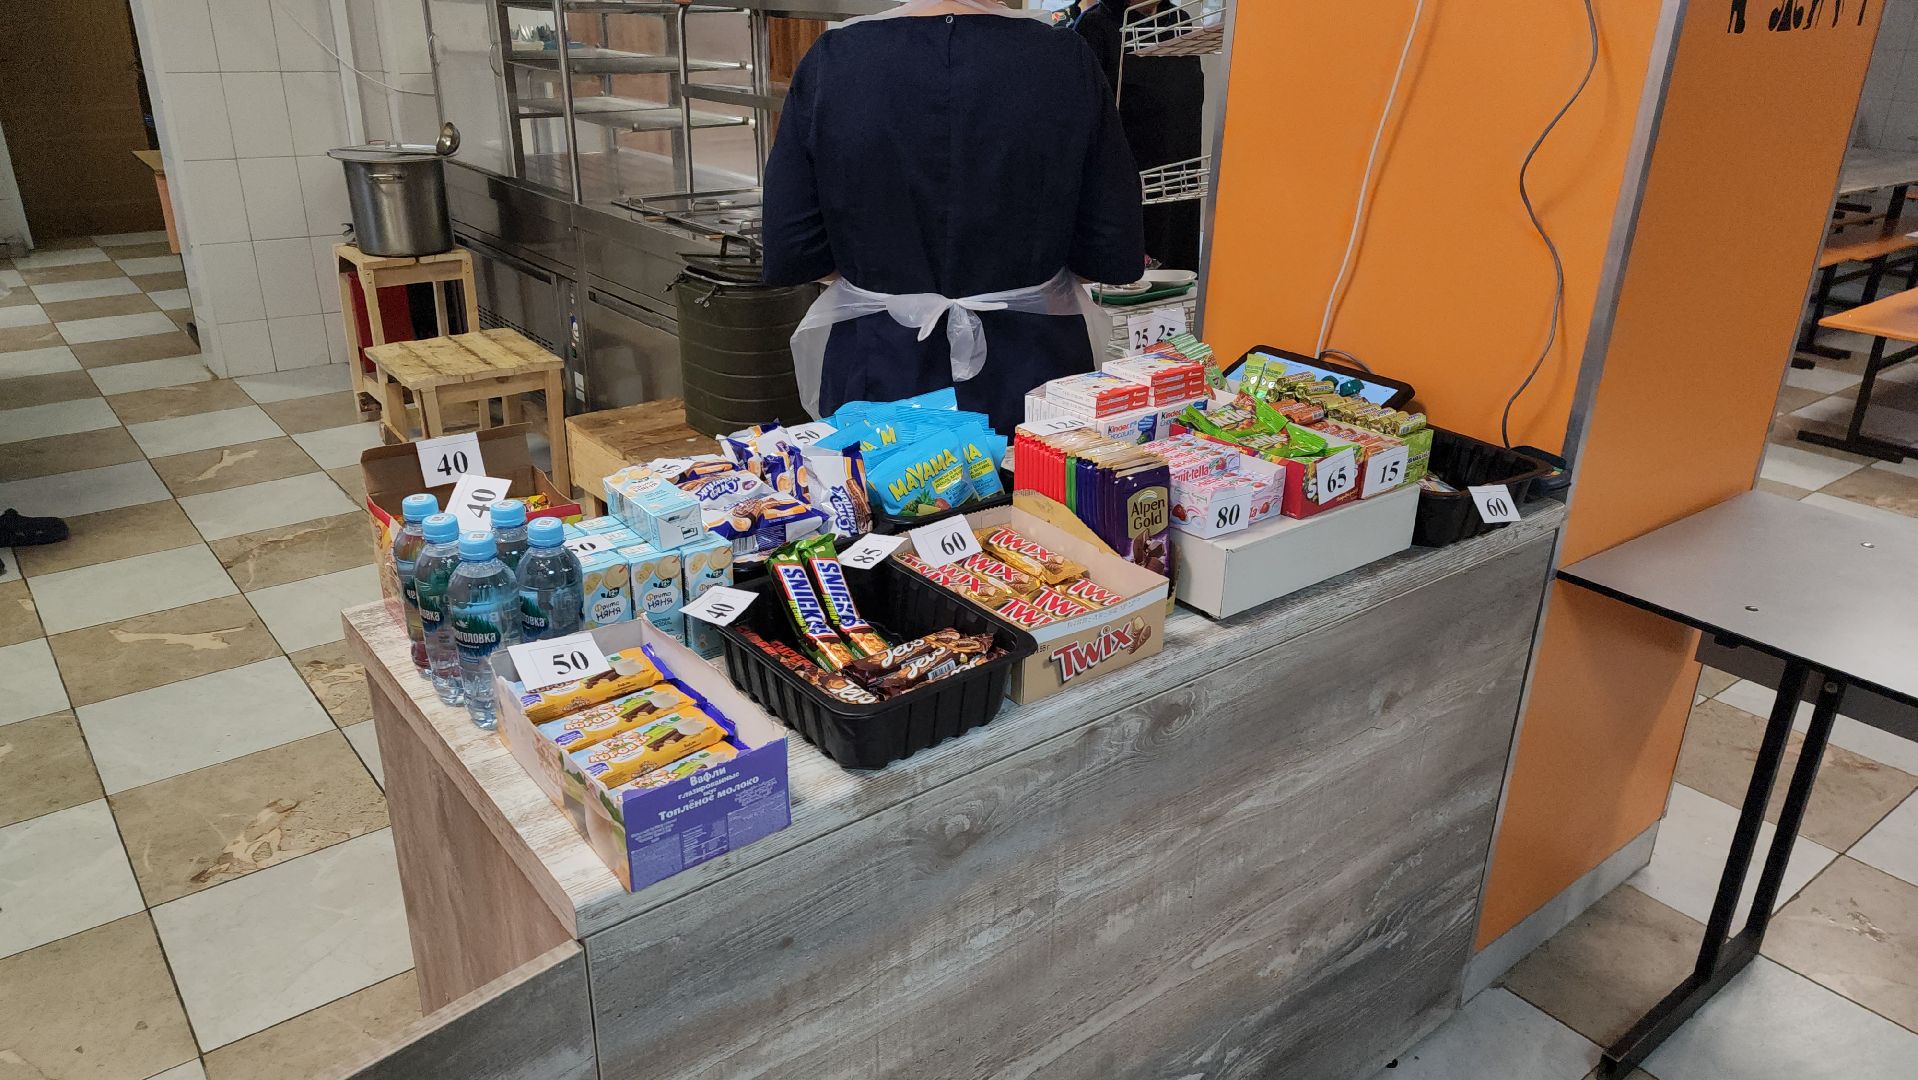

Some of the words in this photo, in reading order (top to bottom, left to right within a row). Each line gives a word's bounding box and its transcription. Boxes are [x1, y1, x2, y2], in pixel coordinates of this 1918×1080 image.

[1134, 327, 1149, 350] 25
[794, 429, 820, 444] 50
[1107, 423, 1130, 437] Kinder
[436, 450, 469, 477] 40
[887, 448, 959, 502] MAYAMA
[1379, 460, 1401, 485] 15
[1327, 465, 1347, 494] 65
[465, 488, 497, 519] 40
[1131, 498, 1166, 518] Alpen
[1486, 497, 1509, 517] 60
[1133, 510, 1163, 530] Gold
[1215, 503, 1240, 529] 80
[940, 531, 967, 556] 60
[595, 607, 622, 621] НЯНЯ
[647, 596, 673, 610] НЯНЯ
[705, 603, 735, 619] 40
[552, 650, 590, 676] 50
[677, 771, 740, 801] глазированные
[689, 766, 727, 787] Вафли
[657, 794, 715, 822] Топлёное
[716, 775, 760, 799] молоко
